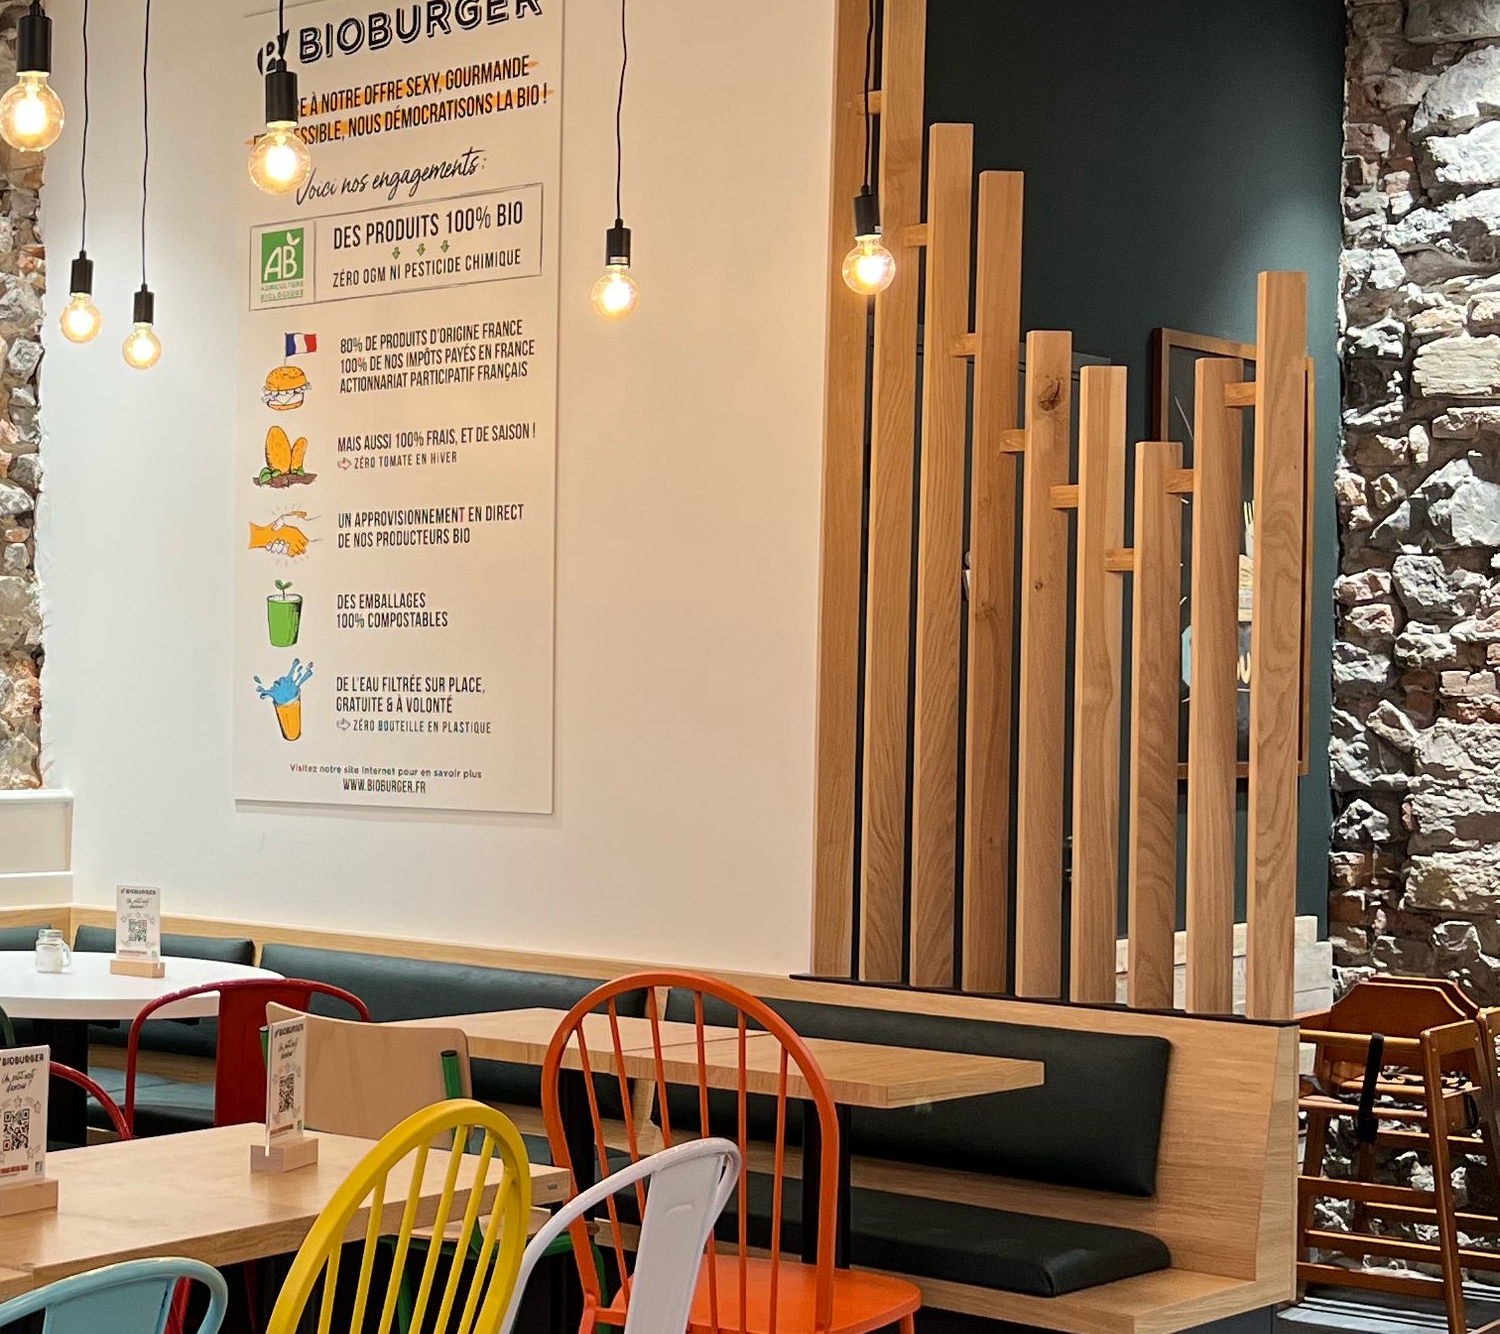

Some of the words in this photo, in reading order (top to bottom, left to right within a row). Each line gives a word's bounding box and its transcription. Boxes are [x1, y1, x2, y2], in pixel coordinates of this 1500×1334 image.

[310, 91, 319, 115] À
[320, 87, 361, 113] NOTRE
[364, 78, 404, 105] OFFRE
[406, 71, 442, 97] SEXY,
[445, 54, 530, 90] GOURMANDE
[348, 113, 381, 138] NOUS
[384, 91, 493, 132] DÉMOCRATISONS
[496, 89, 514, 112] LA
[517, 84, 540, 108] BIO
[341, 173, 369, 195] nos
[333, 225, 361, 250] DES
[366, 213, 439, 246] PRODUITS
[445, 204, 491, 234] 100%
[496, 201, 523, 227] BIO
[262, 245, 297, 281] AB
[333, 269, 359, 288] ZÉRO
[362, 267, 386, 284] OGM
[390, 265, 401, 281] NI
[404, 257, 461, 279] PESTICIDE
[465, 249, 522, 271] CHIMIQUE
[340, 337, 363, 354] 80%
[365, 335, 377, 351] DE
[380, 329, 427, 350] PRODUITS
[482, 319, 523, 339] FRANCE
[340, 357, 367, 374] 100%
[369, 355, 382, 371] DE
[384, 353, 404, 370] NOS
[406, 348, 443, 368] IMPÔTS
[445, 343, 476, 364] PAYÉS
[479, 344, 492, 360] EN
[495, 339, 536, 359] FRANCE
[340, 372, 408, 394] ACTIONNARIAT
[410, 366, 475, 387] PARTICIPATIF
[477, 361, 528, 382] FRANÇAIS
[337, 435, 362, 452] MAIS
[364, 433, 392, 451] AUSSI
[395, 431, 424, 448] 100%
[426, 429, 458, 446] FRAIS,
[460, 427, 473, 444] ET
[476, 425, 489, 442] DE
[491, 423, 530, 441] SAISON
[354, 455, 376, 469] ZÉRO
[378, 454, 412, 468] TOMATE
[416, 453, 427, 466] EN
[430, 451, 457, 465] HIVER
[338, 512, 351, 528] UN
[354, 506, 465, 527] APPROVISIONNEMENT
[468, 505, 482, 522] EN
[485, 503, 524, 521] DIRECT
[338, 532, 351, 549] DE
[353, 531, 373, 547] NOS
[376, 529, 450, 547] PRODUCTEURS
[453, 527, 470, 544] BIO
[337, 594, 356, 610] DES
[359, 592, 426, 609] EMBALLAGES
[336, 612, 364, 628] 100%
[367, 610, 448, 628] COMPOSTABLES
[336, 676, 349, 692] DE
[382, 674, 422, 692] FILTRÉE
[425, 676, 445, 693] SUR
[449, 676, 486, 695] PLACE,
[336, 696, 383, 712] GRATUITE
[386, 697, 393, 712] &
[396, 694, 403, 713] À
[406, 694, 452, 713] VOLONTÉ
[353, 717, 375, 731] ZÉRO
[378, 719, 424, 733] BOUTEILLE
[428, 721, 439, 733] EN
[442, 721, 491, 734] PLASTIQUE
[319, 765, 341, 774] notre
[398, 767, 418, 777] pour
[420, 769, 431, 777] en
[433, 769, 461, 778] savoir
[463, 769, 482, 779] plus
[342, 778, 426, 794] WWW.BIOBURGER.FR
